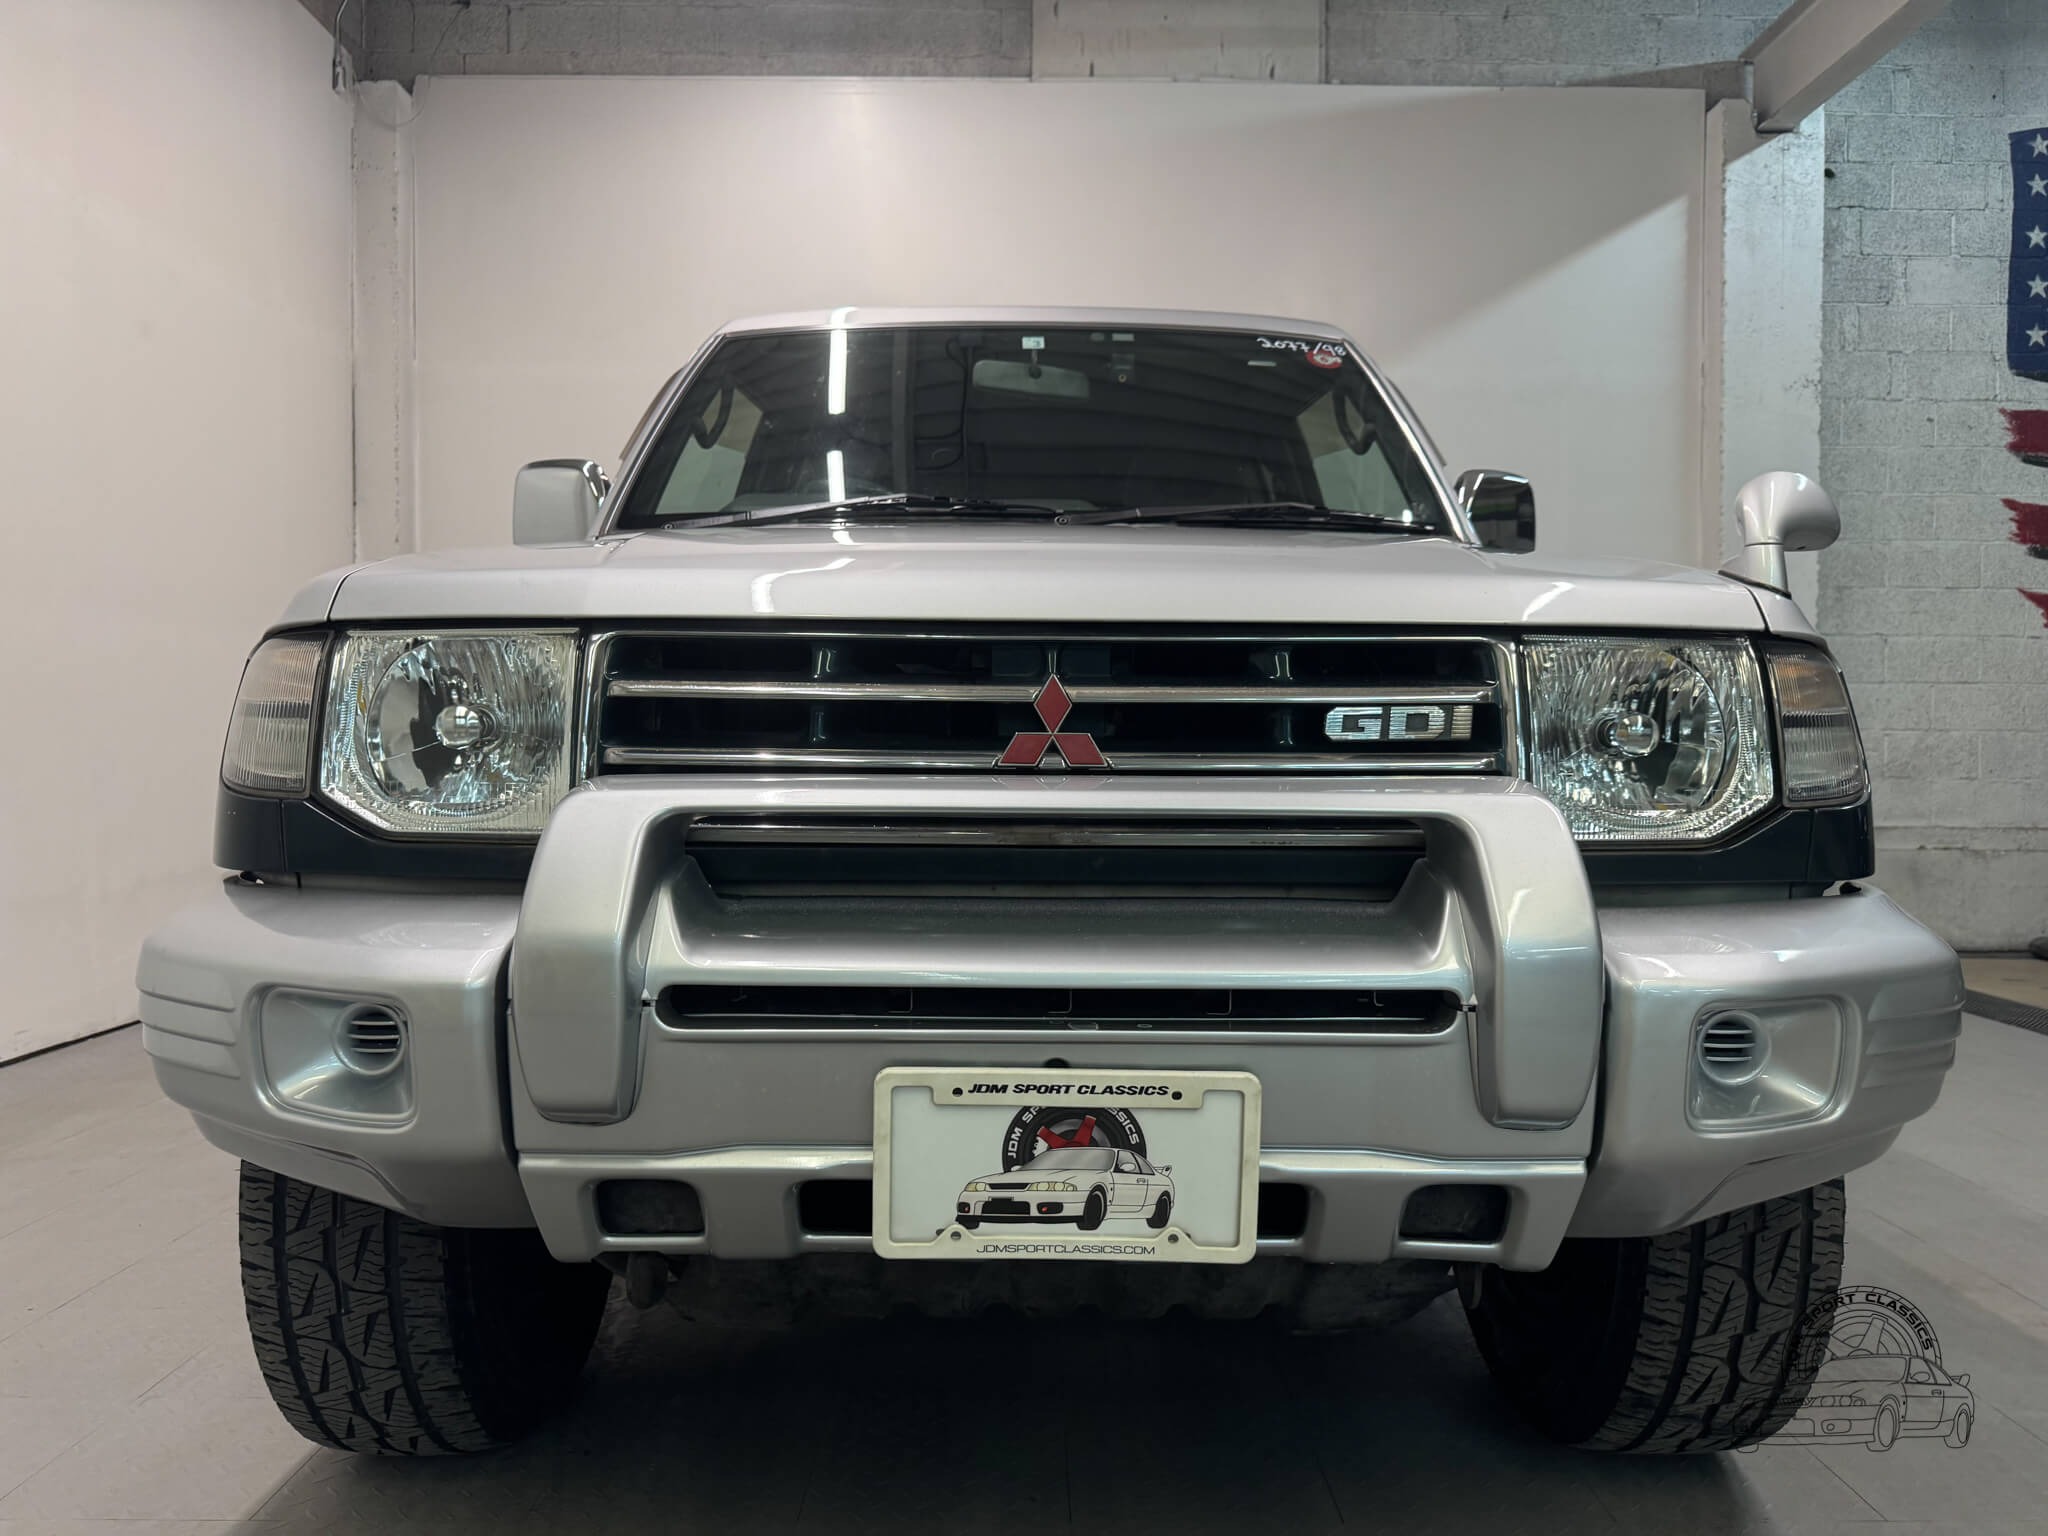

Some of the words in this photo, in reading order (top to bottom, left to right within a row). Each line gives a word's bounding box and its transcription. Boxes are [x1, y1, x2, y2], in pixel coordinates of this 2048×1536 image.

[968, 1083, 1008, 1094] JDM
[1013, 1084, 1075, 1095] SPORT
[1077, 1085, 1169, 1096] CLASSICS
[1008, 1126, 1023, 1159] JDM
[1105, 1107, 1140, 1145] SSICS
[976, 1244, 1156, 1255] JDMSPORTCLASSICS.COM
